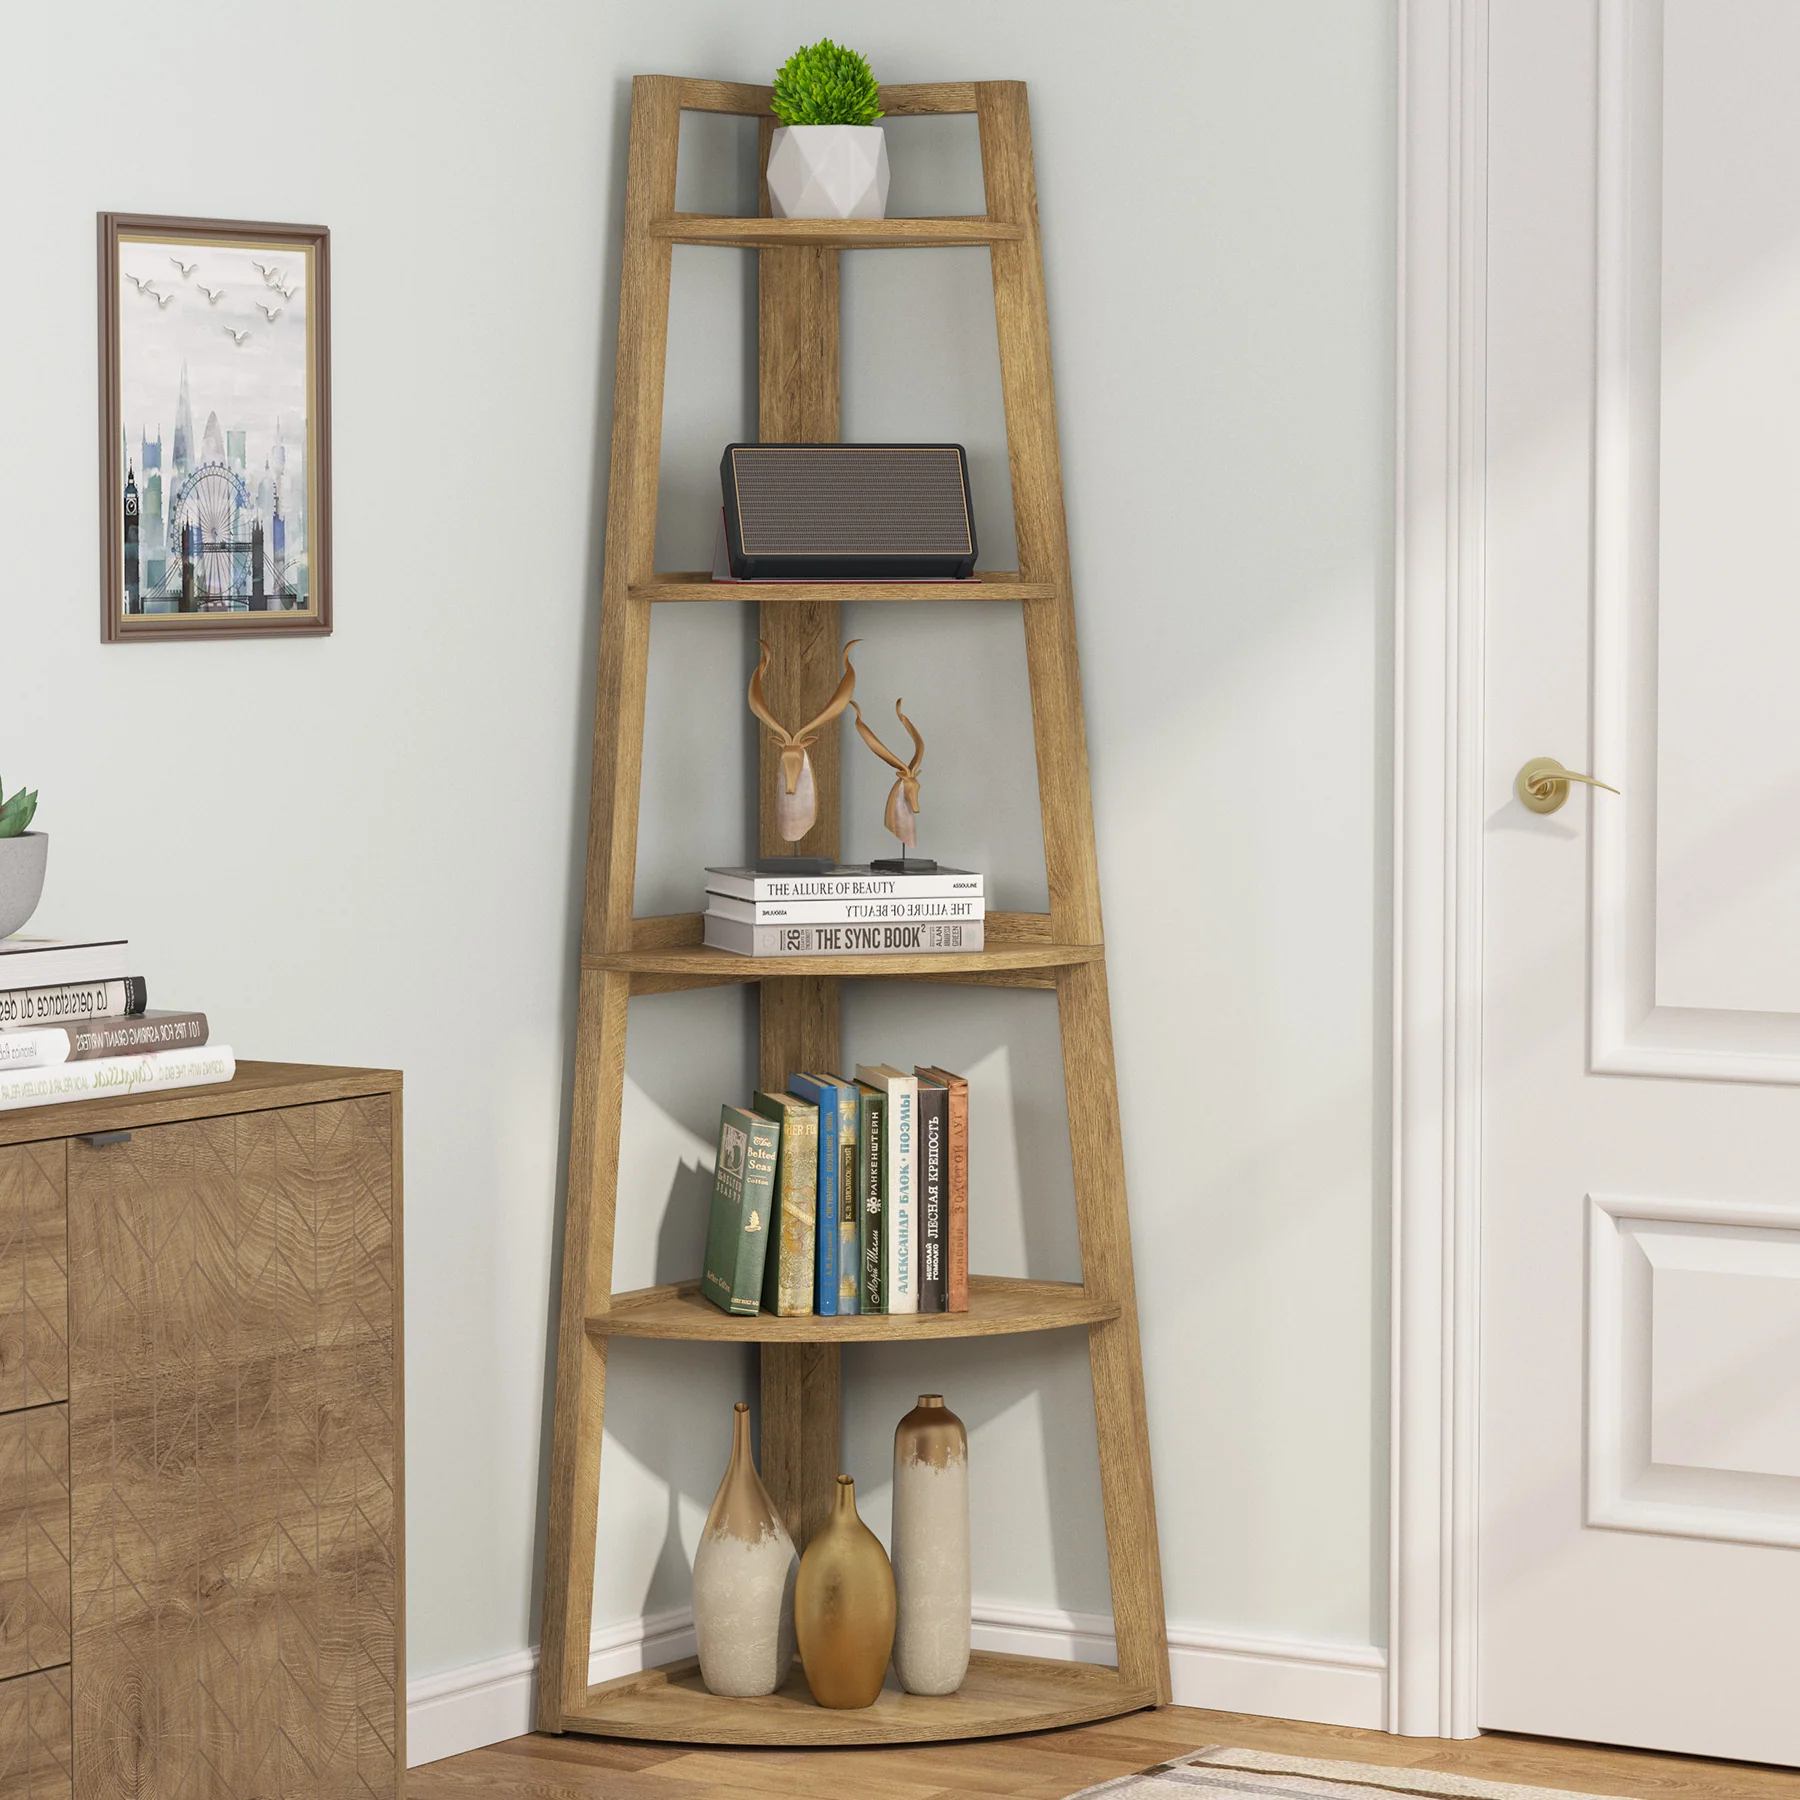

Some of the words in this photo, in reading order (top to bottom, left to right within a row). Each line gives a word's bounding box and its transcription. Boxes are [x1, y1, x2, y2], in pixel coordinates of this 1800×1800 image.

[767, 883, 790, 896] THE
[792, 882, 834, 896] ALLURE
[835, 881, 851, 895] OF
[852, 881, 896, 894] BEAUTY
[787, 929, 801, 951] 26
[815, 928, 843, 950] THE
[844, 927, 881, 950] SYNC
[899, 1094, 911, 1154] ПОЭМЫ
[747, 1147, 776, 1161] Belted
[753, 1136, 773, 1148] The
[928, 1116, 939, 1182] КРЕПОСТЬ
[748, 1160, 772, 1172] Seas
[899, 1164, 909, 1205] БЛОК
[927, 1185, 939, 1239] ЛЕСНАЯ
[897, 1209, 909, 1294] АЛЕКСАНДР
[925, 1242, 933, 1281] НИКОЛАЙ
